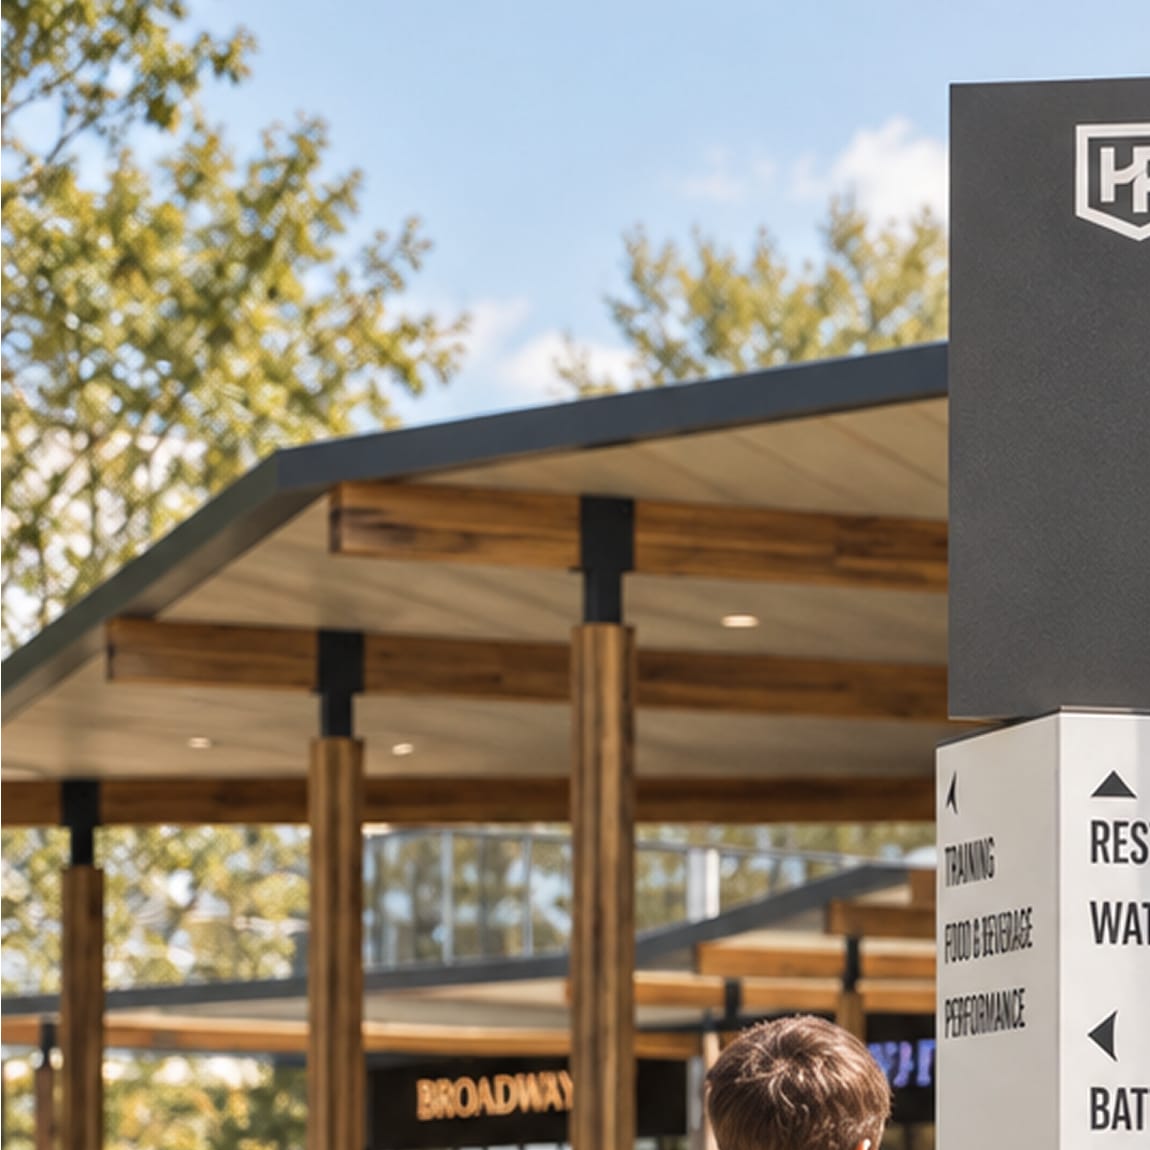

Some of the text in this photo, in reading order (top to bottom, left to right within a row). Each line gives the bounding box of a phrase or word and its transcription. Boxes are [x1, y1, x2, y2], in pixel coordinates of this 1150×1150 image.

[944, 836, 995, 887] TRAINING
[981, 906, 1033, 958] BEVERAGE
[944, 987, 1026, 1039] PERFORMANCE
